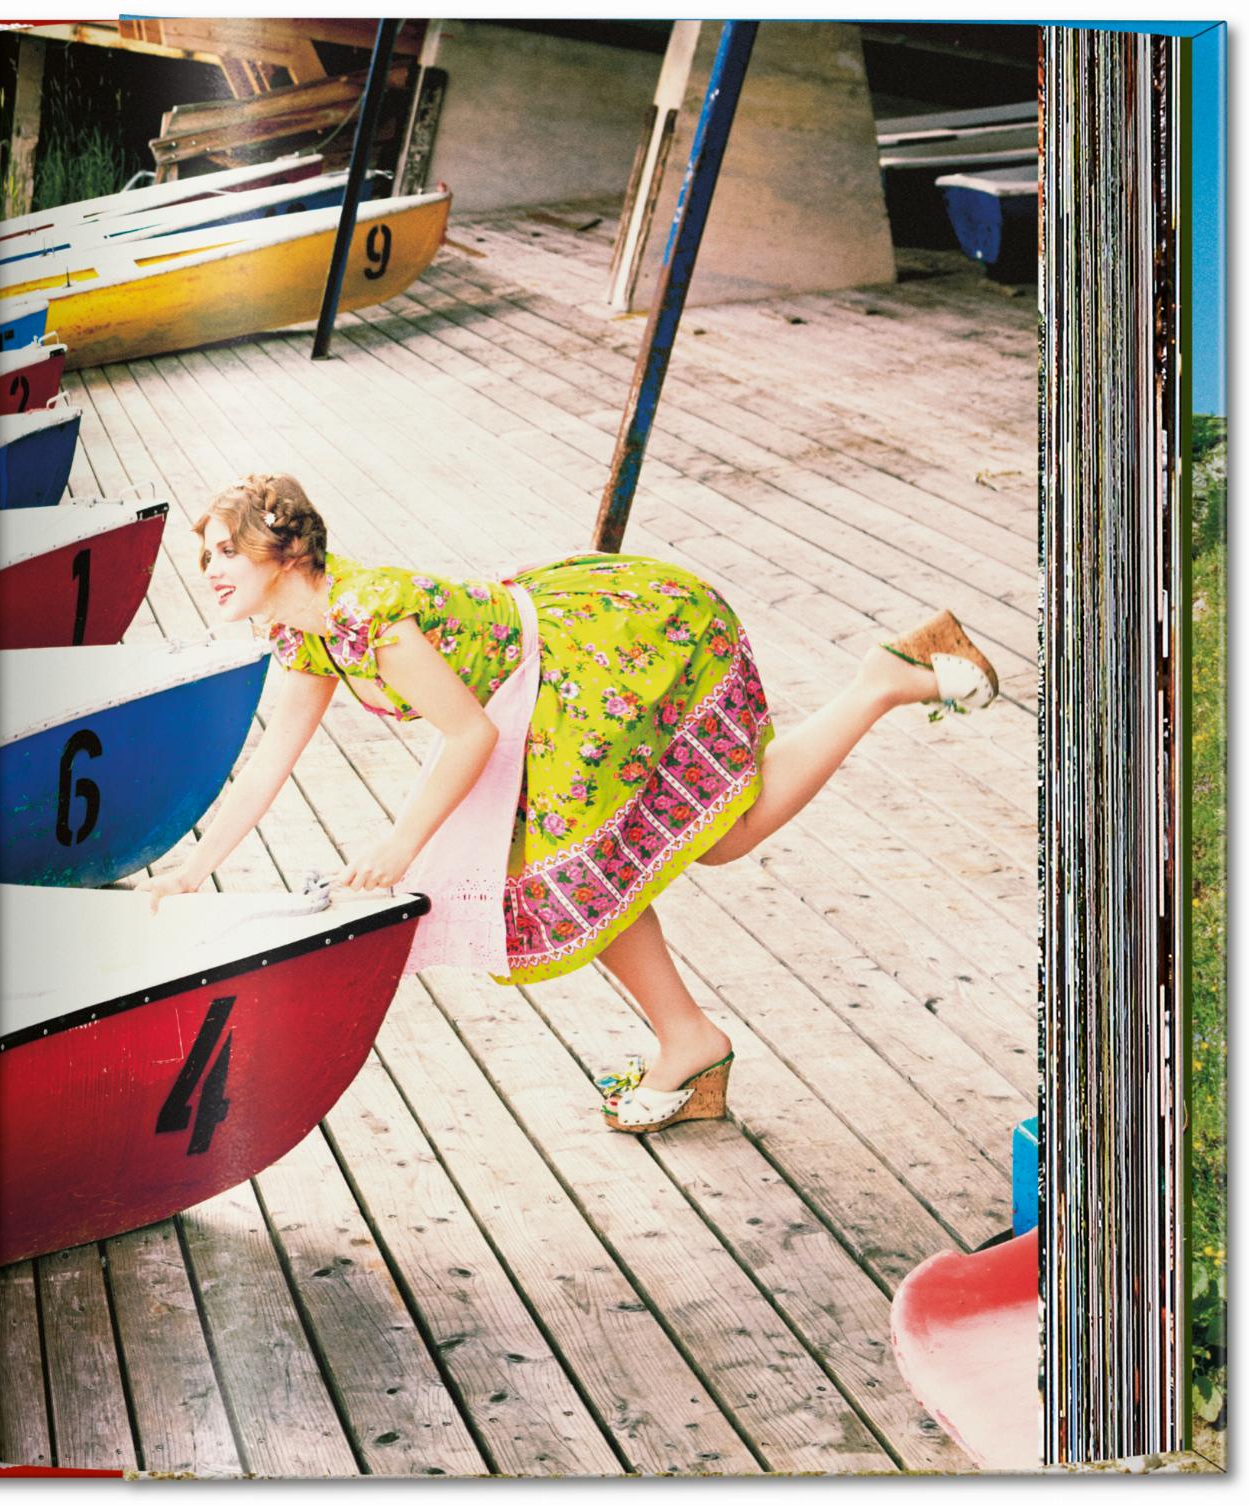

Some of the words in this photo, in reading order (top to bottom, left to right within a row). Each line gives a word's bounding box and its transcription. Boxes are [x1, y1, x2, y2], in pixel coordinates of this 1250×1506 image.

[364, 224, 391, 280] 9
[72, 548, 90, 646] 1
[56, 729, 103, 847] 6
[155, 996, 237, 1156] 4
